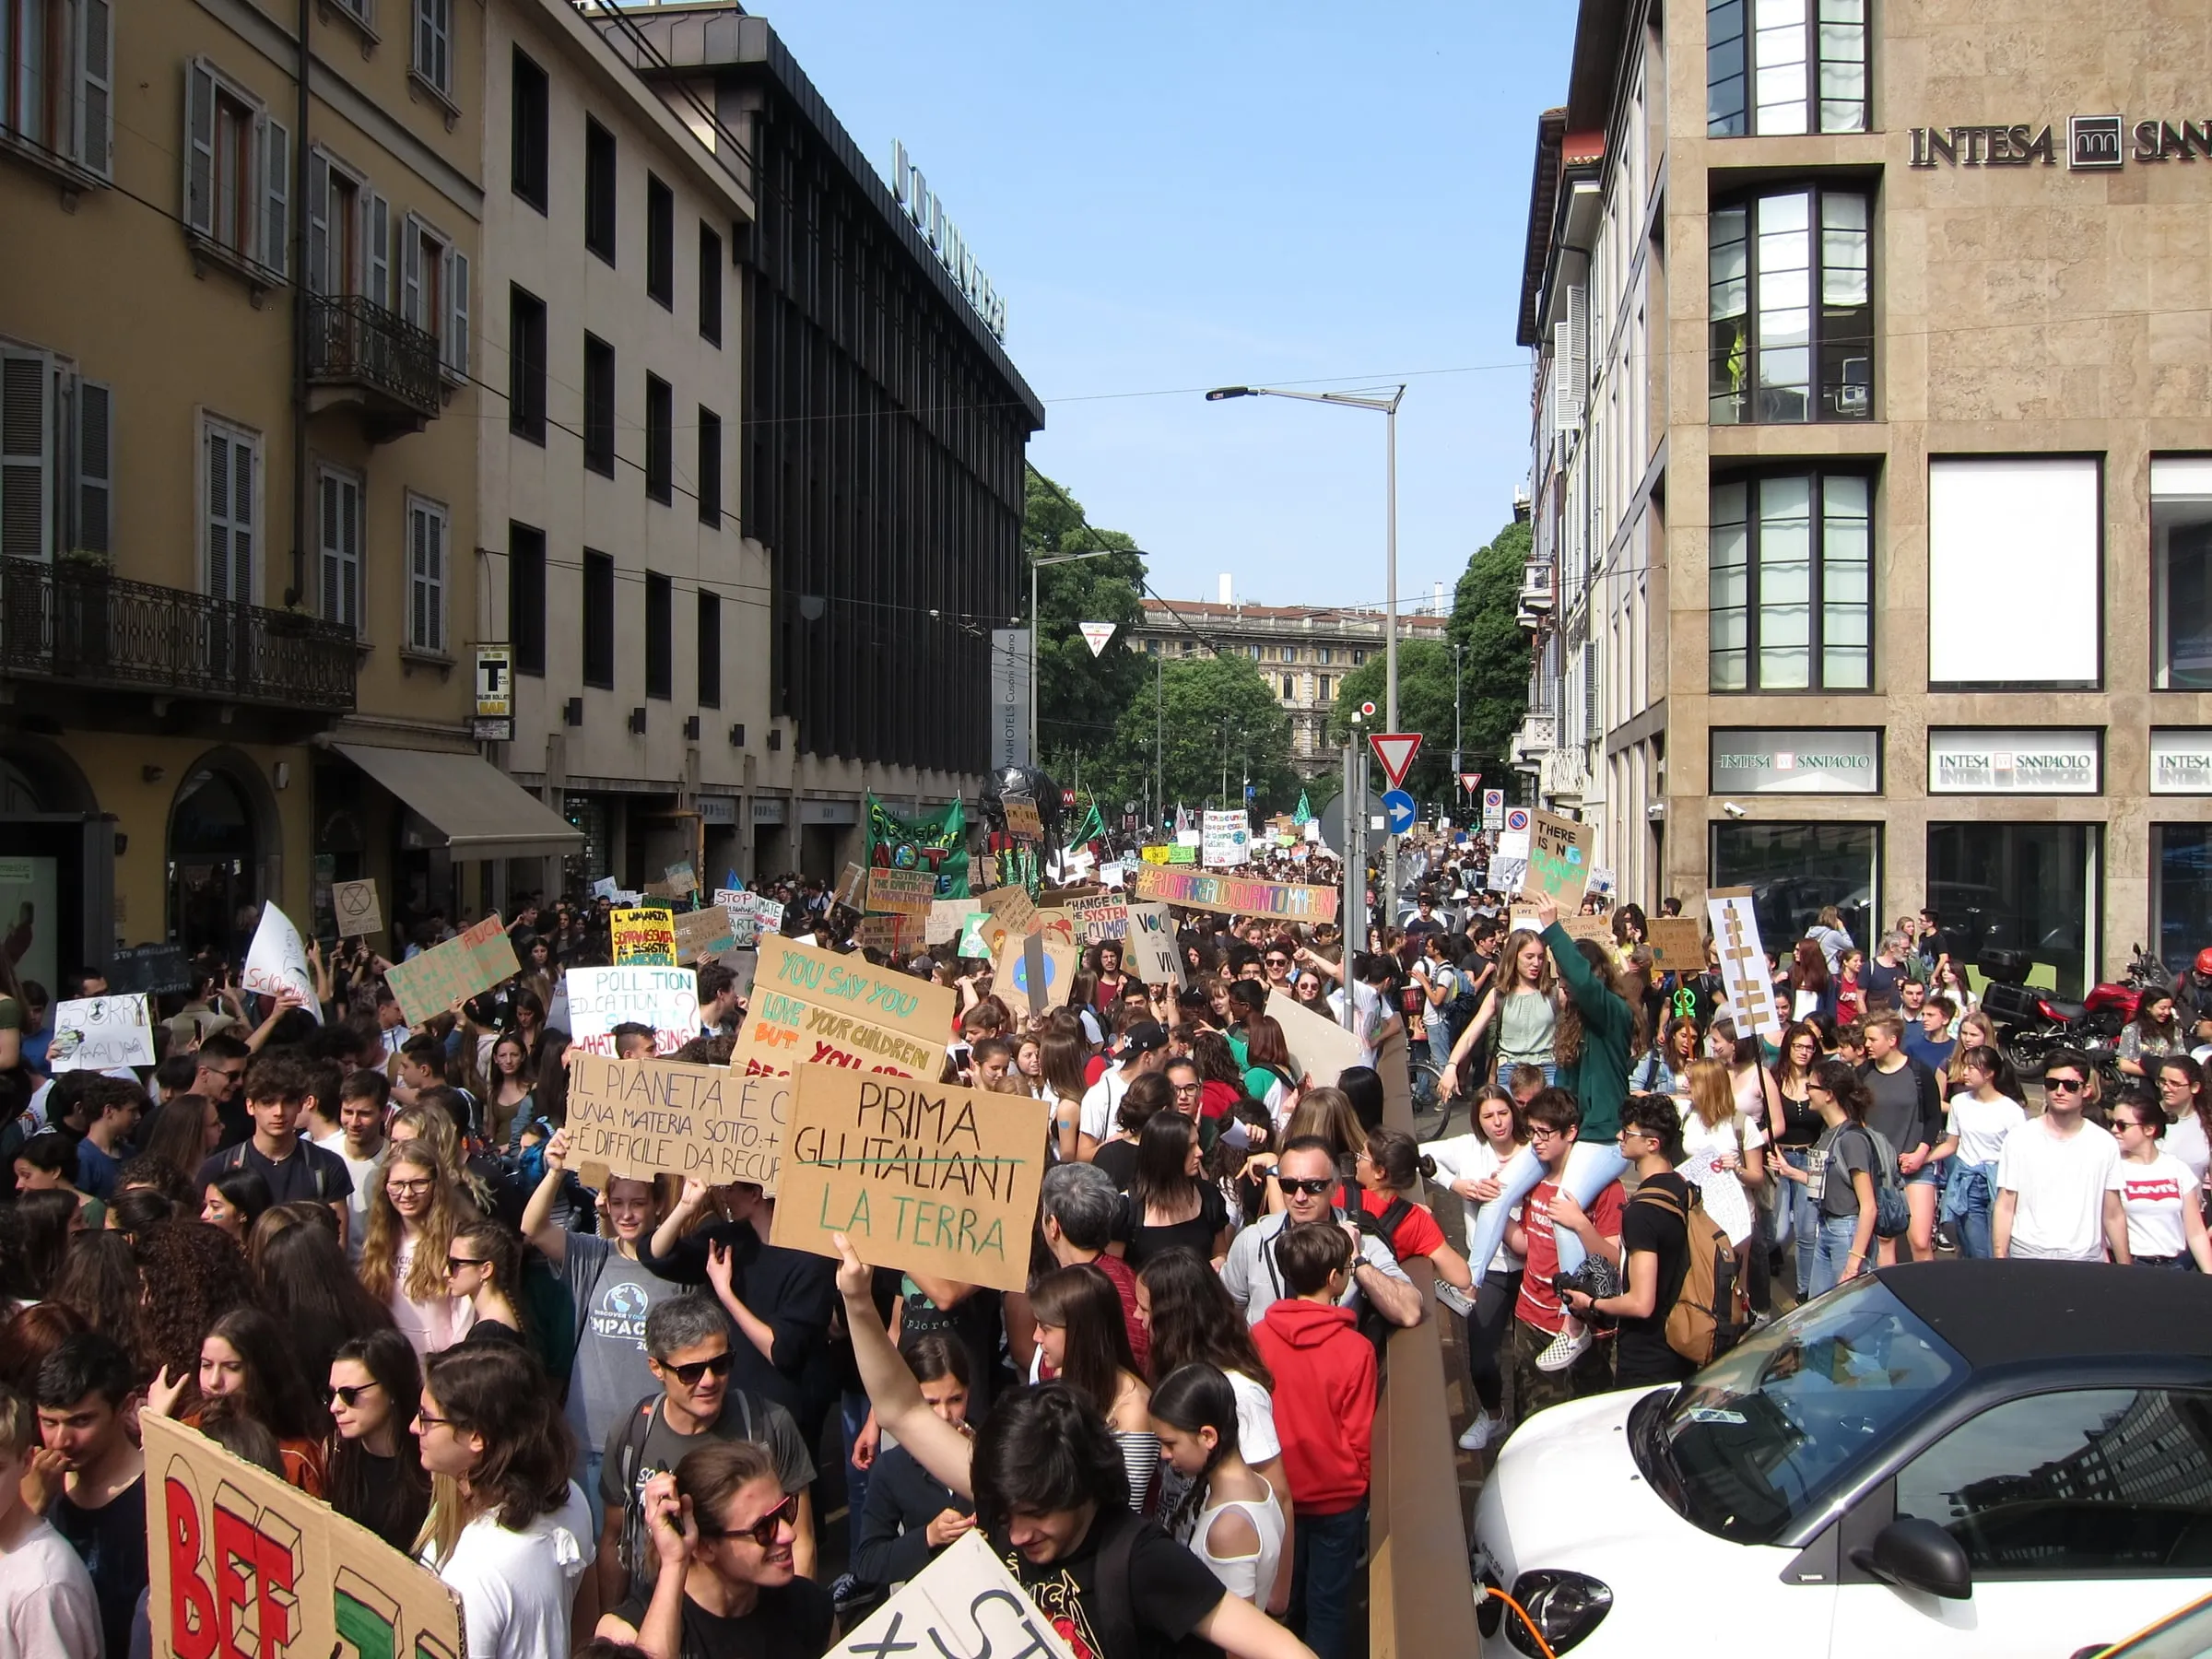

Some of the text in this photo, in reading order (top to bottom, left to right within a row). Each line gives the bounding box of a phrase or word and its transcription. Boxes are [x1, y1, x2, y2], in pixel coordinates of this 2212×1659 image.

[1908, 124, 2056, 167] INTESA
[479, 661, 507, 691] T
[1006, 633, 1015, 769] NAHOTELS Cusani Milano
[1720, 754, 1870, 769] INTESA SANPAOLO
[1938, 755, 2090, 769] INTESA SANPAOLO
[2158, 755, 2212, 769] INTESA
[1537, 820, 1576, 843] THERE
[1538, 836, 1548, 850] IS
[871, 841, 950, 872] NOT
[1531, 848, 1587, 886] PLANET
[871, 868, 890, 879] STOP
[716, 890, 752, 905] STOP
[755, 897, 782, 917] LIMATE
[1084, 906, 1127, 922] SYSTEM
[463, 917, 504, 950] FUCK
[778, 950, 919, 1018] YOU SAY YOU
[762, 992, 806, 1027] LOVE
[806, 1007, 853, 1041] YOUR
[571, 1031, 616, 1056] WHAT
[755, 1022, 799, 1050] BUT
[573, 1060, 594, 1096] IL
[606, 1064, 723, 1115] PIANETA
[571, 1098, 615, 1127] UNA
[622, 1108, 693, 1136] MATERIA
[857, 1081, 981, 1150] PRIMA
[595, 1128, 673, 1167] DIFFICILE
[685, 1143, 714, 1173] DA
[794, 1126, 845, 1171] GLI
[819, 1182, 1005, 1262] LA TERRA
[594, 1309, 627, 1319] DISCOVER
